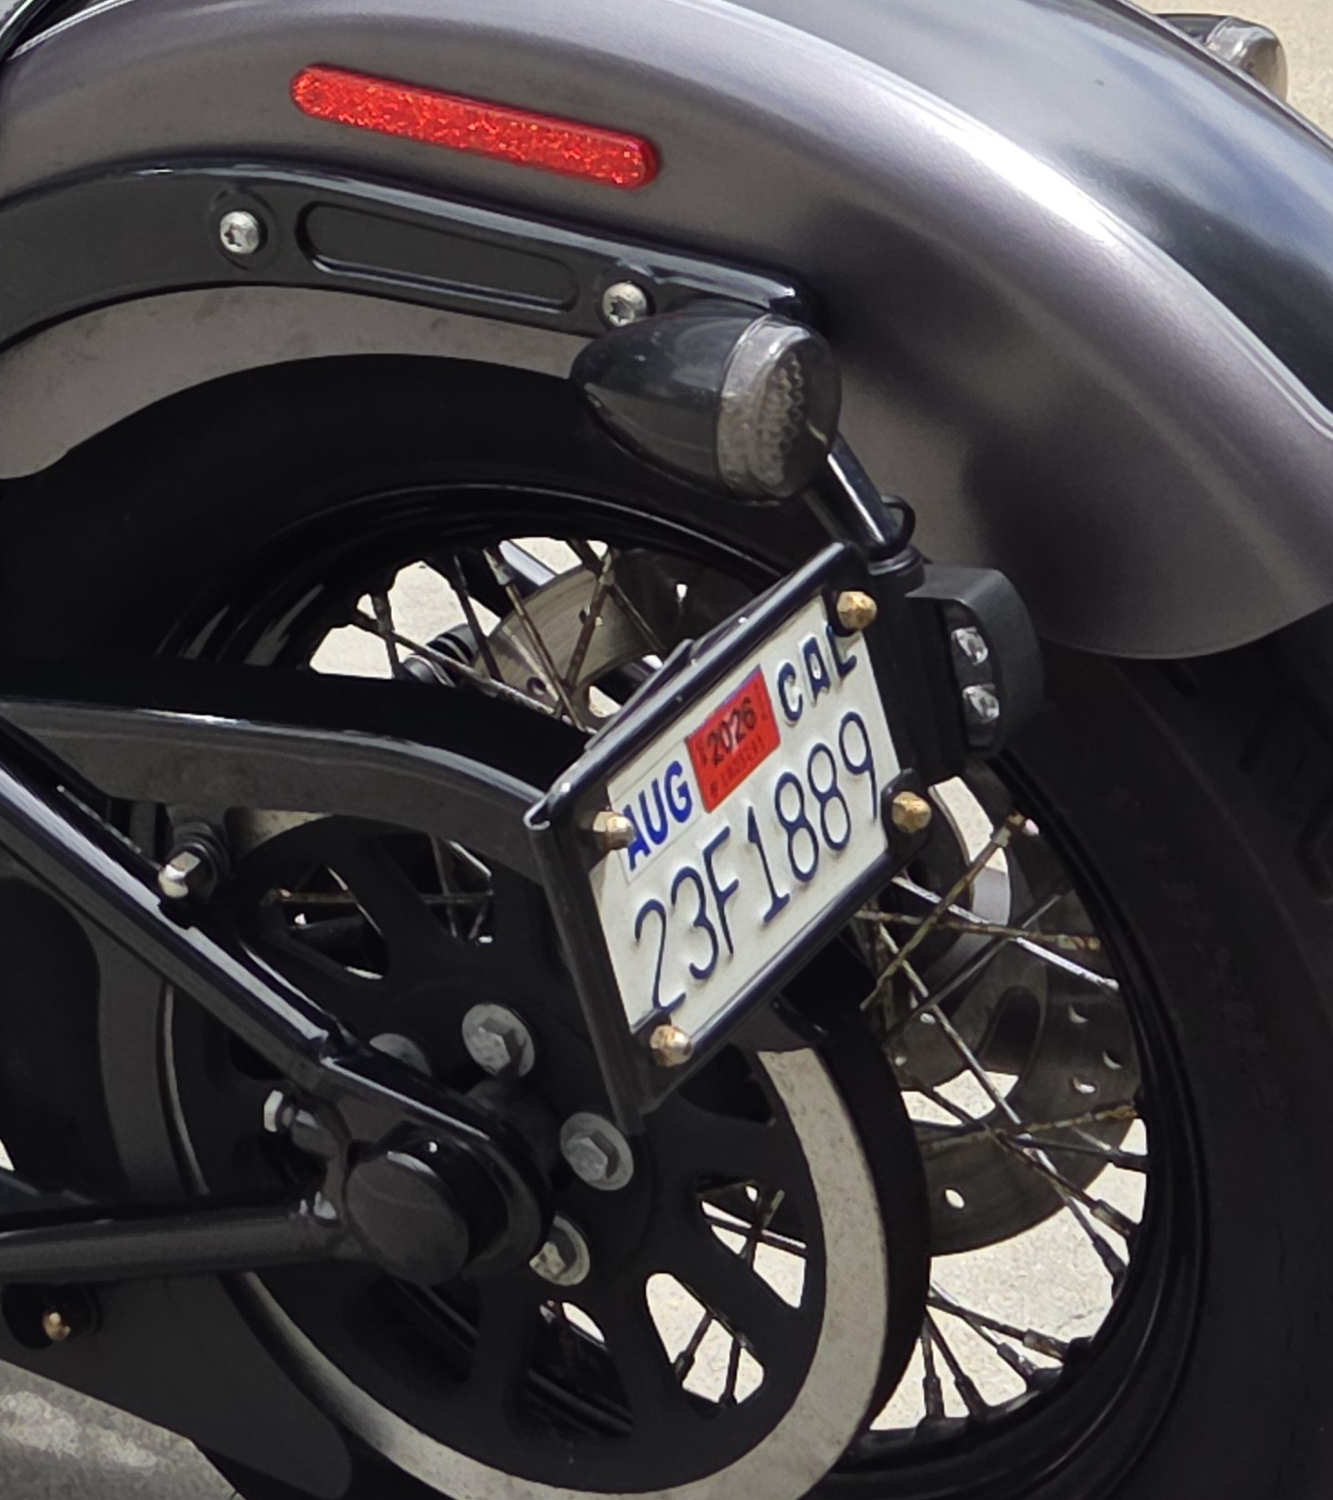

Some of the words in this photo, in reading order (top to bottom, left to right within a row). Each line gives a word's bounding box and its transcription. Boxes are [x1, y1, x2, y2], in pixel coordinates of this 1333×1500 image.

[777, 621, 857, 722] CAL
[706, 696, 755, 766] 2026
[623, 760, 693, 871] AUG
[635, 711, 878, 1013] 23F1889
